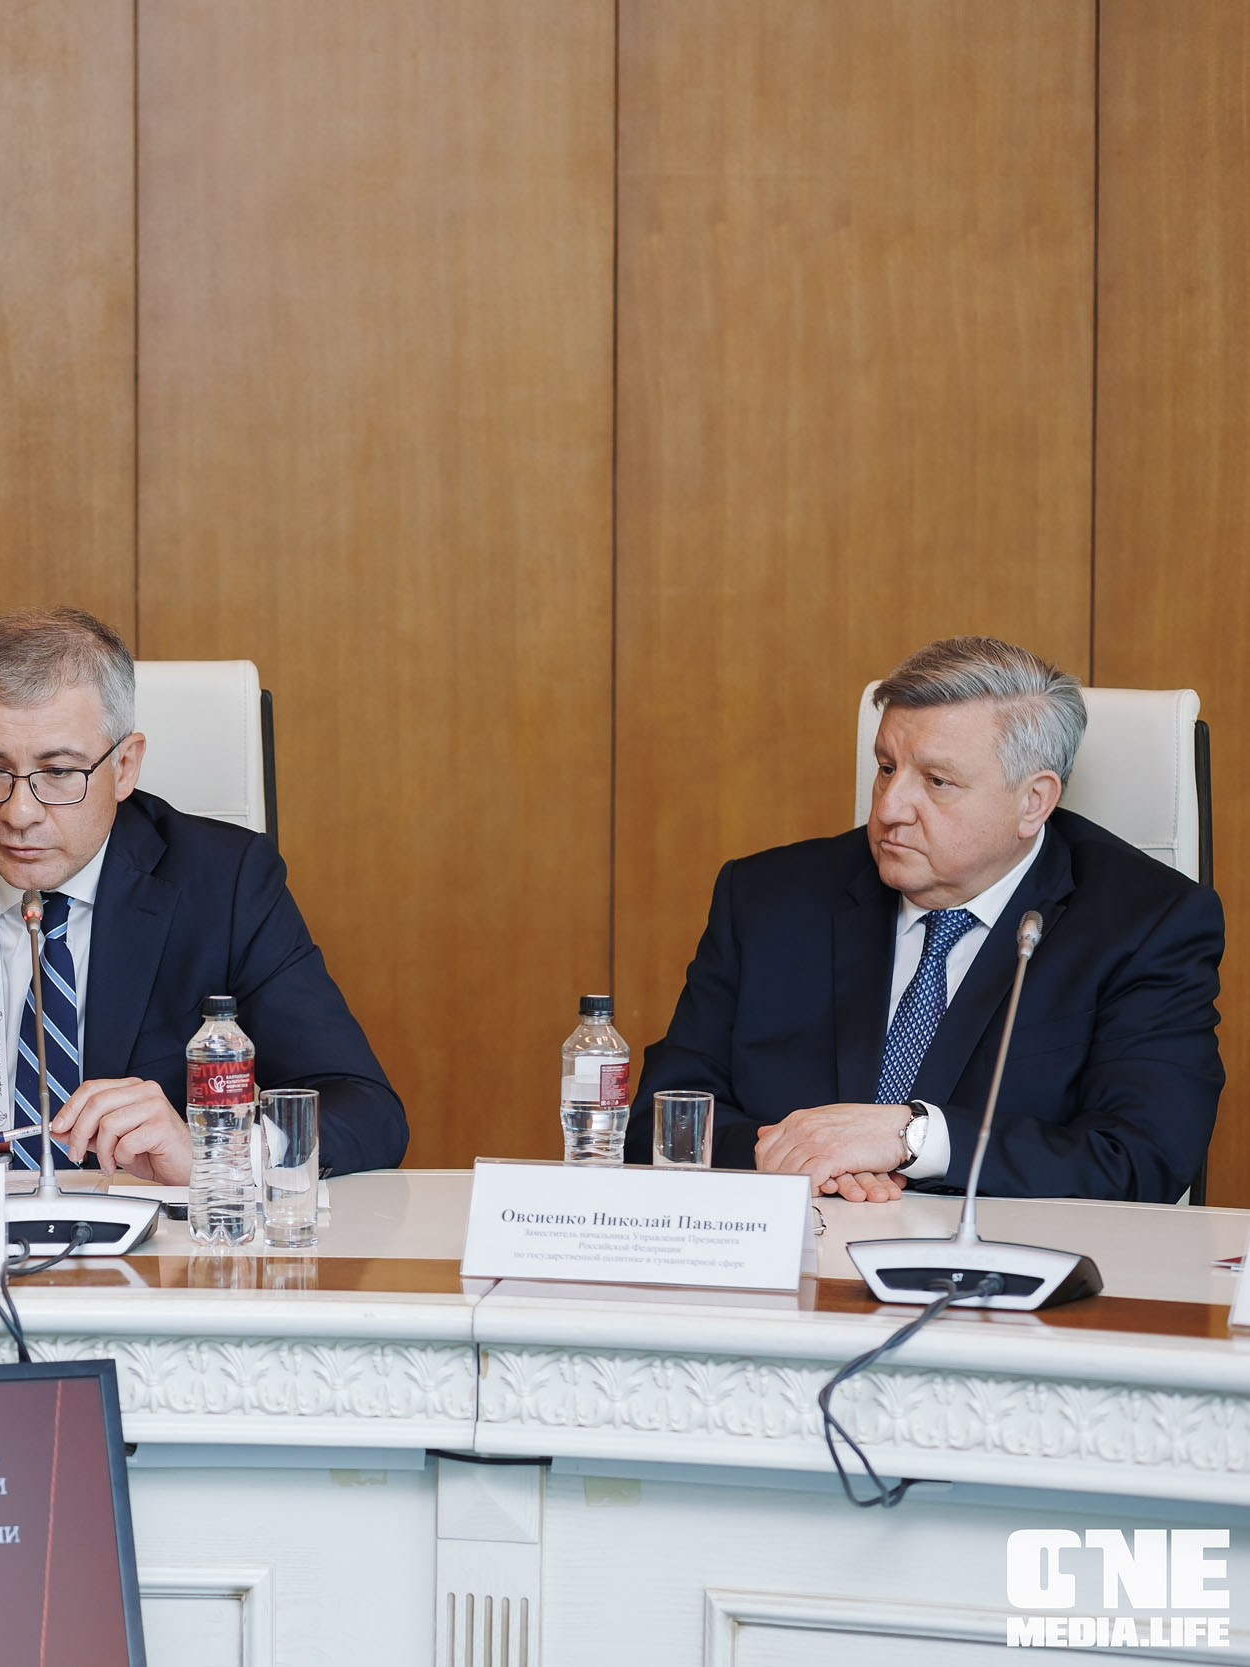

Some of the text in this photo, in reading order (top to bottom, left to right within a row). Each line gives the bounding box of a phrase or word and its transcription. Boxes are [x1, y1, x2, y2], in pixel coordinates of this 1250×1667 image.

[48, 1224, 55, 1233] 2
[501, 1208, 768, 1233] Овсиенко Николай Павлович
